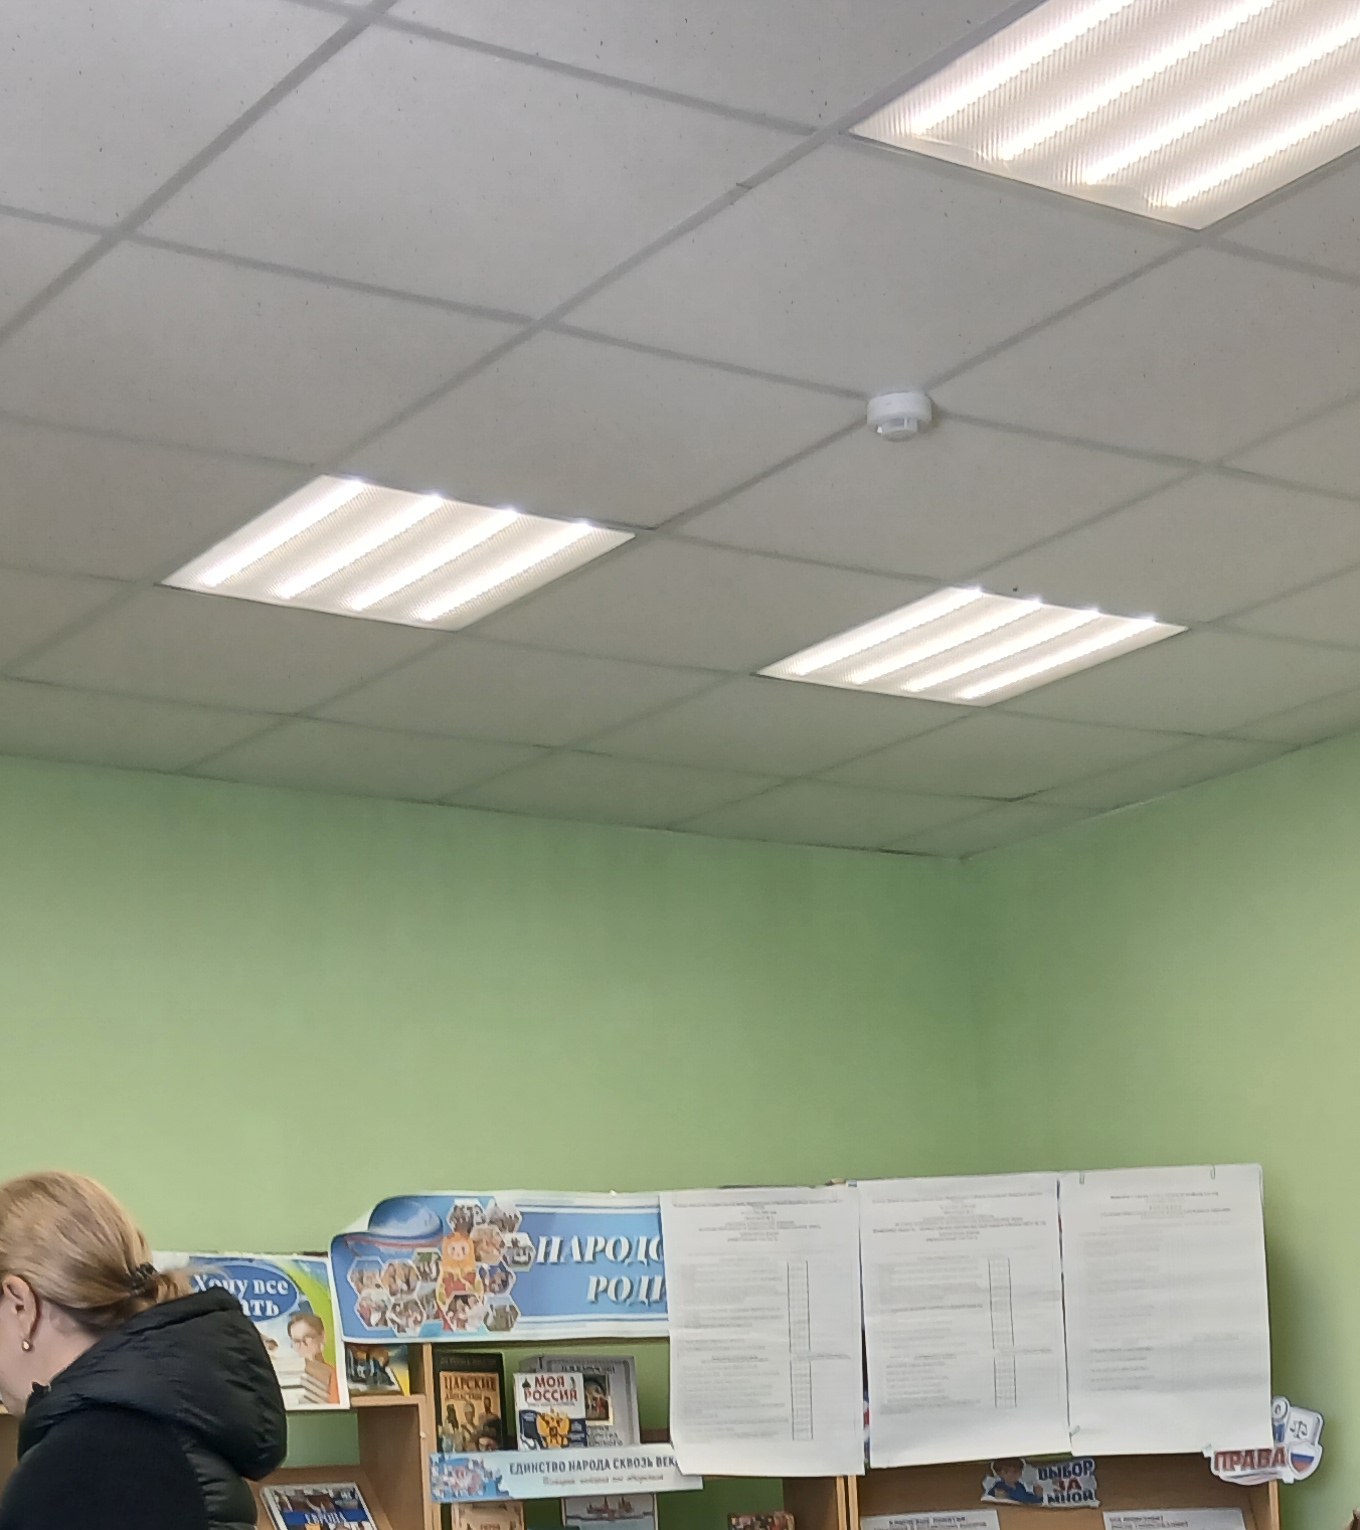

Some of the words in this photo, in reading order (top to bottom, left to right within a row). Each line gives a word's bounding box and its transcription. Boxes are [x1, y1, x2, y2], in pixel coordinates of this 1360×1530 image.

[253, 1278, 289, 1295] все
[534, 1375, 565, 1388] МОЯ
[525, 1388, 578, 1402] РОССИЯ
[509, 1460, 565, 1475] ЕДИНСТВО
[568, 1459, 611, 1472] НАРОДА
[613, 1456, 653, 1470] СКВОЗЬ
[656, 1456, 677, 1468] ВЕК
[1214, 1447, 1287, 1471] ПРАВА
